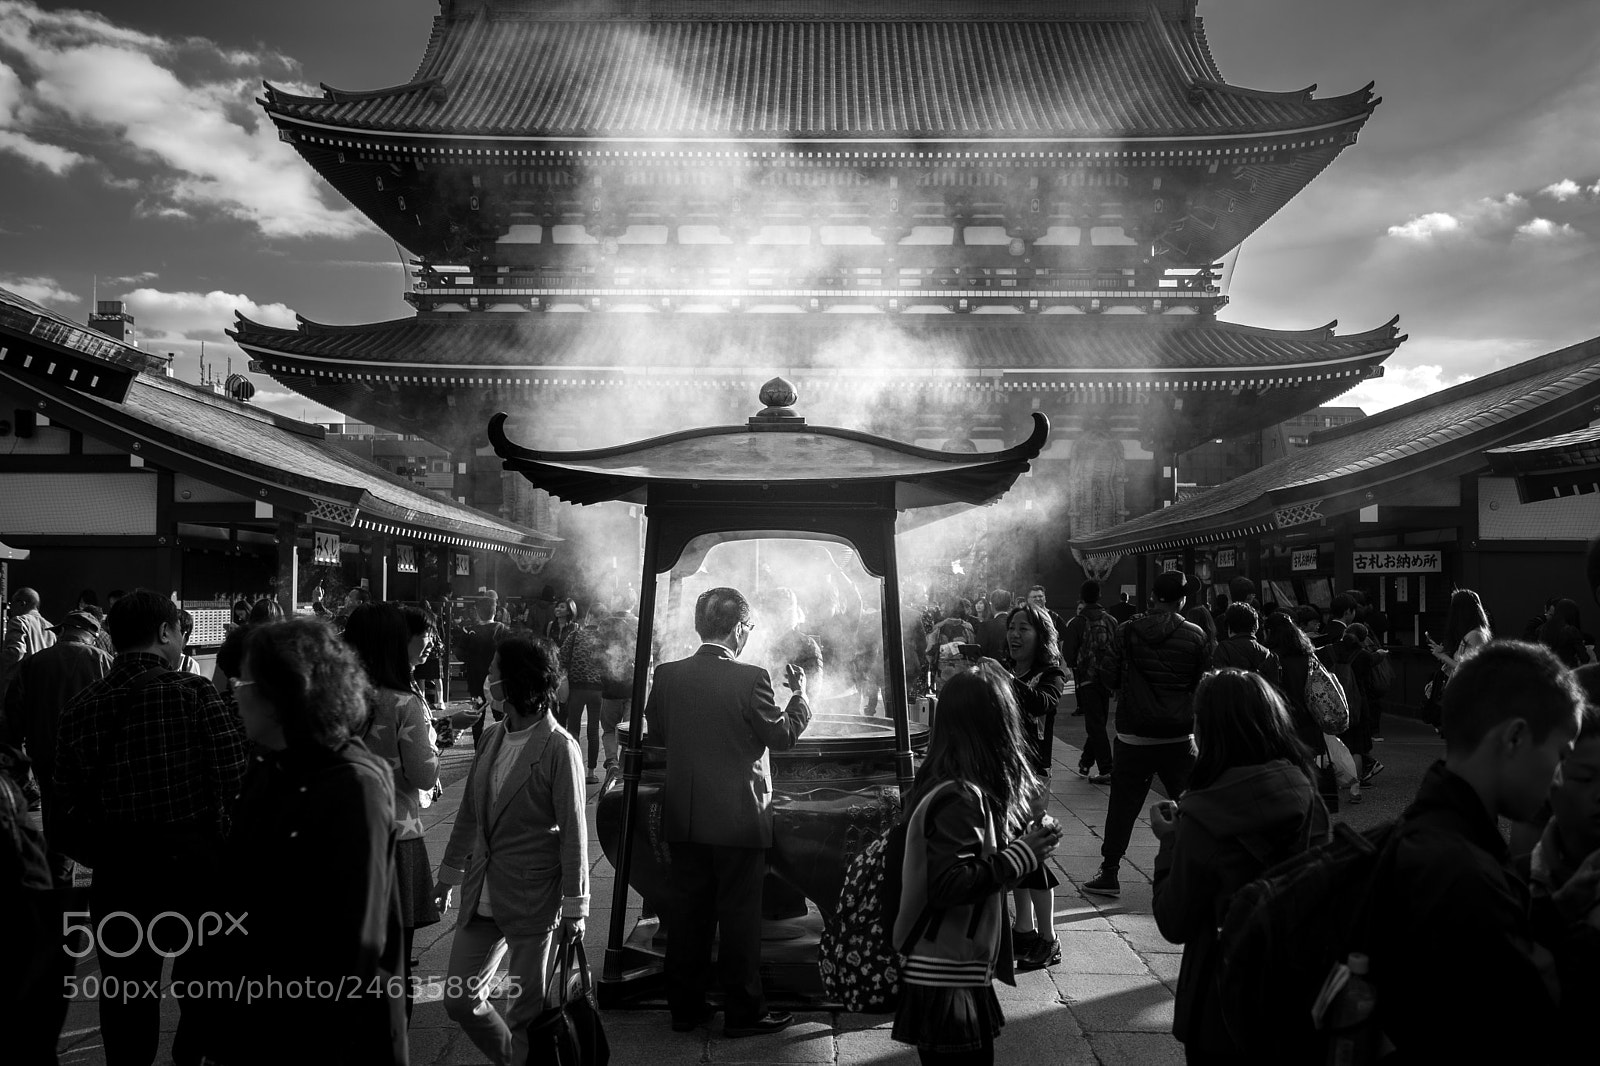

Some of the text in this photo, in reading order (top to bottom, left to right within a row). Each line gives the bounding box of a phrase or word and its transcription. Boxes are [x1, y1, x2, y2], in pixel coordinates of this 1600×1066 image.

[1354, 553, 1438, 570] 古札お納め所
